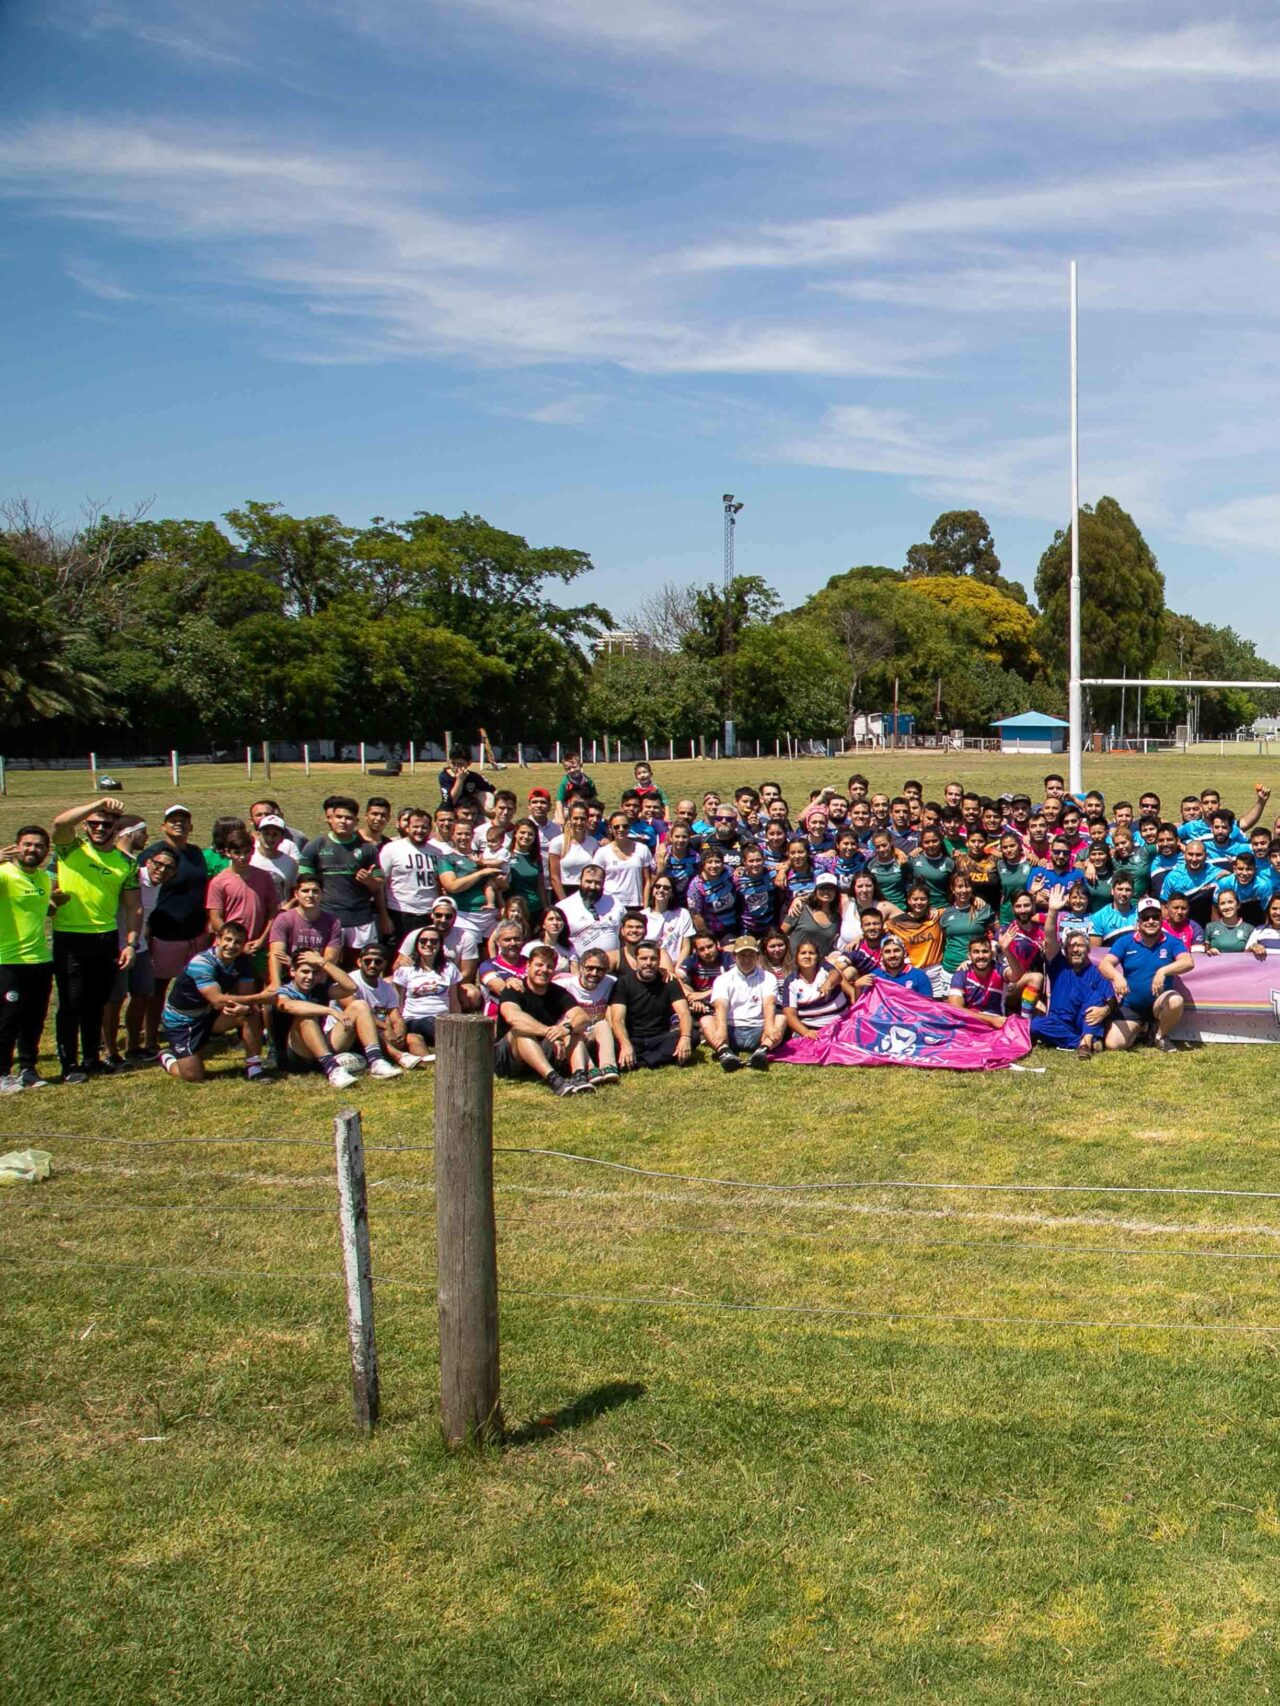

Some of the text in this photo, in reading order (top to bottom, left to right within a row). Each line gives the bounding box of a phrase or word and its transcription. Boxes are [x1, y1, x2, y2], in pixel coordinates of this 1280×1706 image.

[405, 854, 438, 872] JOIN
[416, 870, 435, 887] ME
[909, 932, 934, 945] VISA
